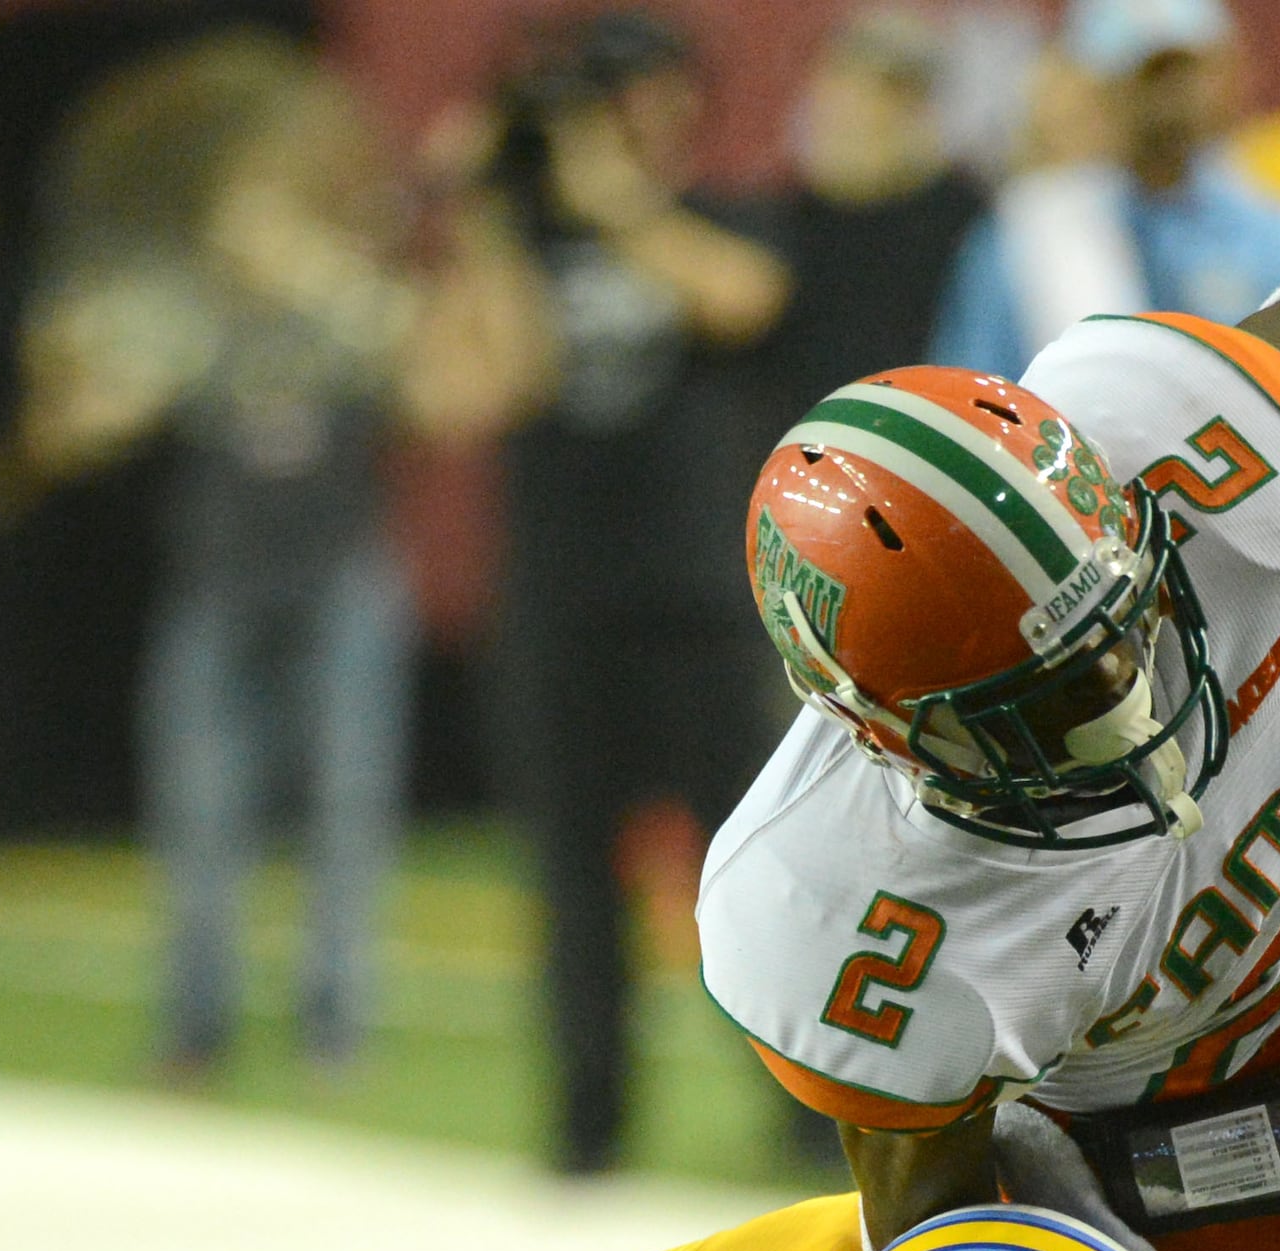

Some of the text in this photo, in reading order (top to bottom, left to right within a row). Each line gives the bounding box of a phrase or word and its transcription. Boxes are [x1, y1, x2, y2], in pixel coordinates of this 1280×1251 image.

[1129, 414, 1279, 546] 2
[820, 889, 947, 1049] 2
[1077, 906, 1121, 972] RUSSELL
